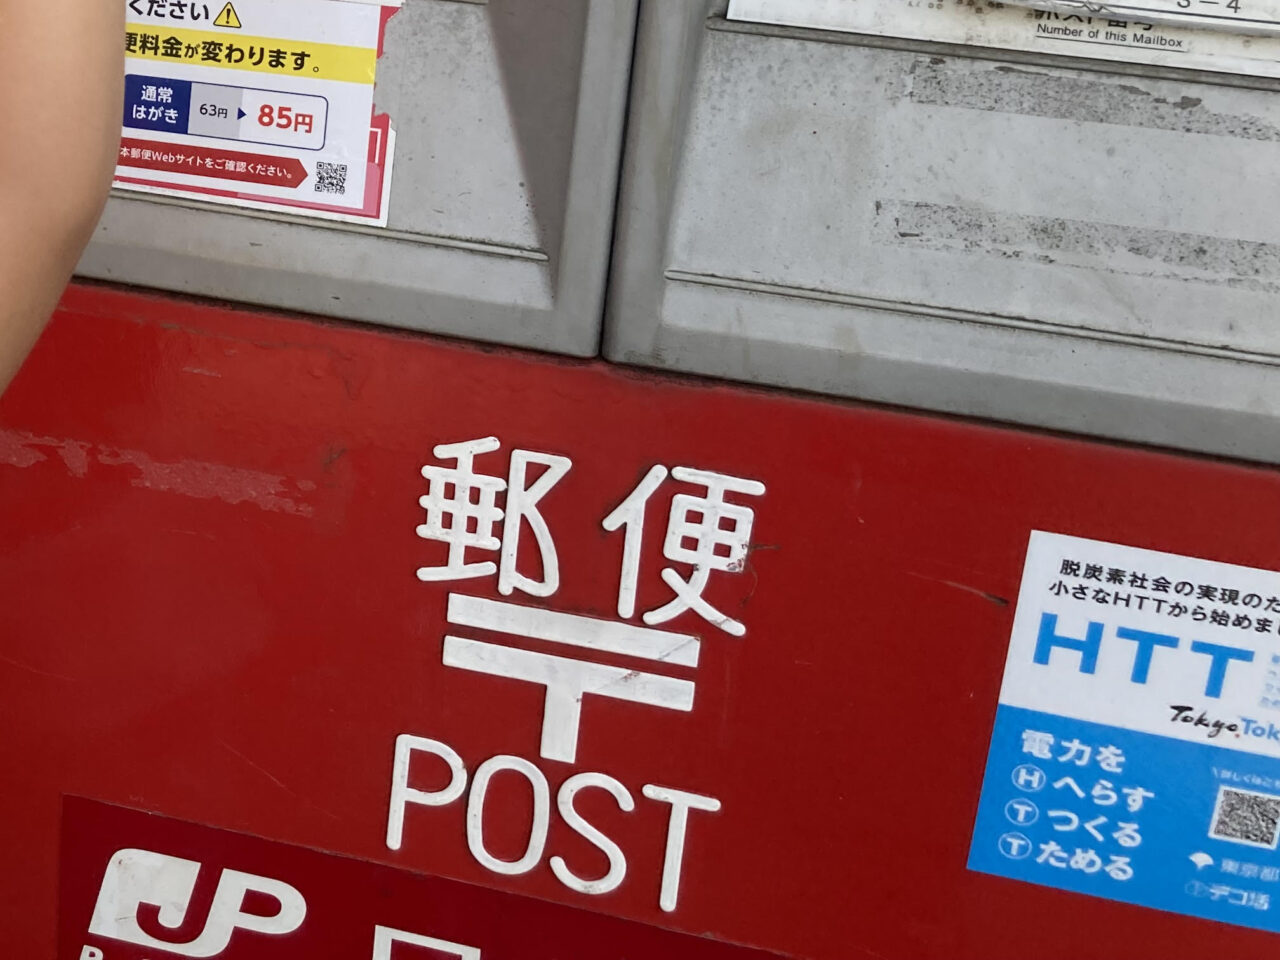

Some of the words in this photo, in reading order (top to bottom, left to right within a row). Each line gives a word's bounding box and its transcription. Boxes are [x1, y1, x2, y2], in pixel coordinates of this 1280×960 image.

[1036, 23, 1084, 38] Number
[1088, 29, 1100, 39] of
[1105, 30, 1128, 42] this
[1132, 33, 1183, 48] Mailbox
[132, 104, 179, 124] はがき
[140, 84, 173, 103] 通常
[199, 103, 228, 120] 63円
[257, 104, 314, 134] 85円
[416, 436, 767, 637] 郵便
[1048, 580, 1280, 636] 小さなHTTから始めま
[1033, 612, 1255, 700] HTT
[1021, 728, 1126, 773] 電力を
[1053, 775, 1155, 812] へらす
[385, 733, 721, 913] POST
[1047, 809, 1142, 847] つくる
[1036, 840, 1134, 881] ためる
[87, 848, 307, 958] JP
